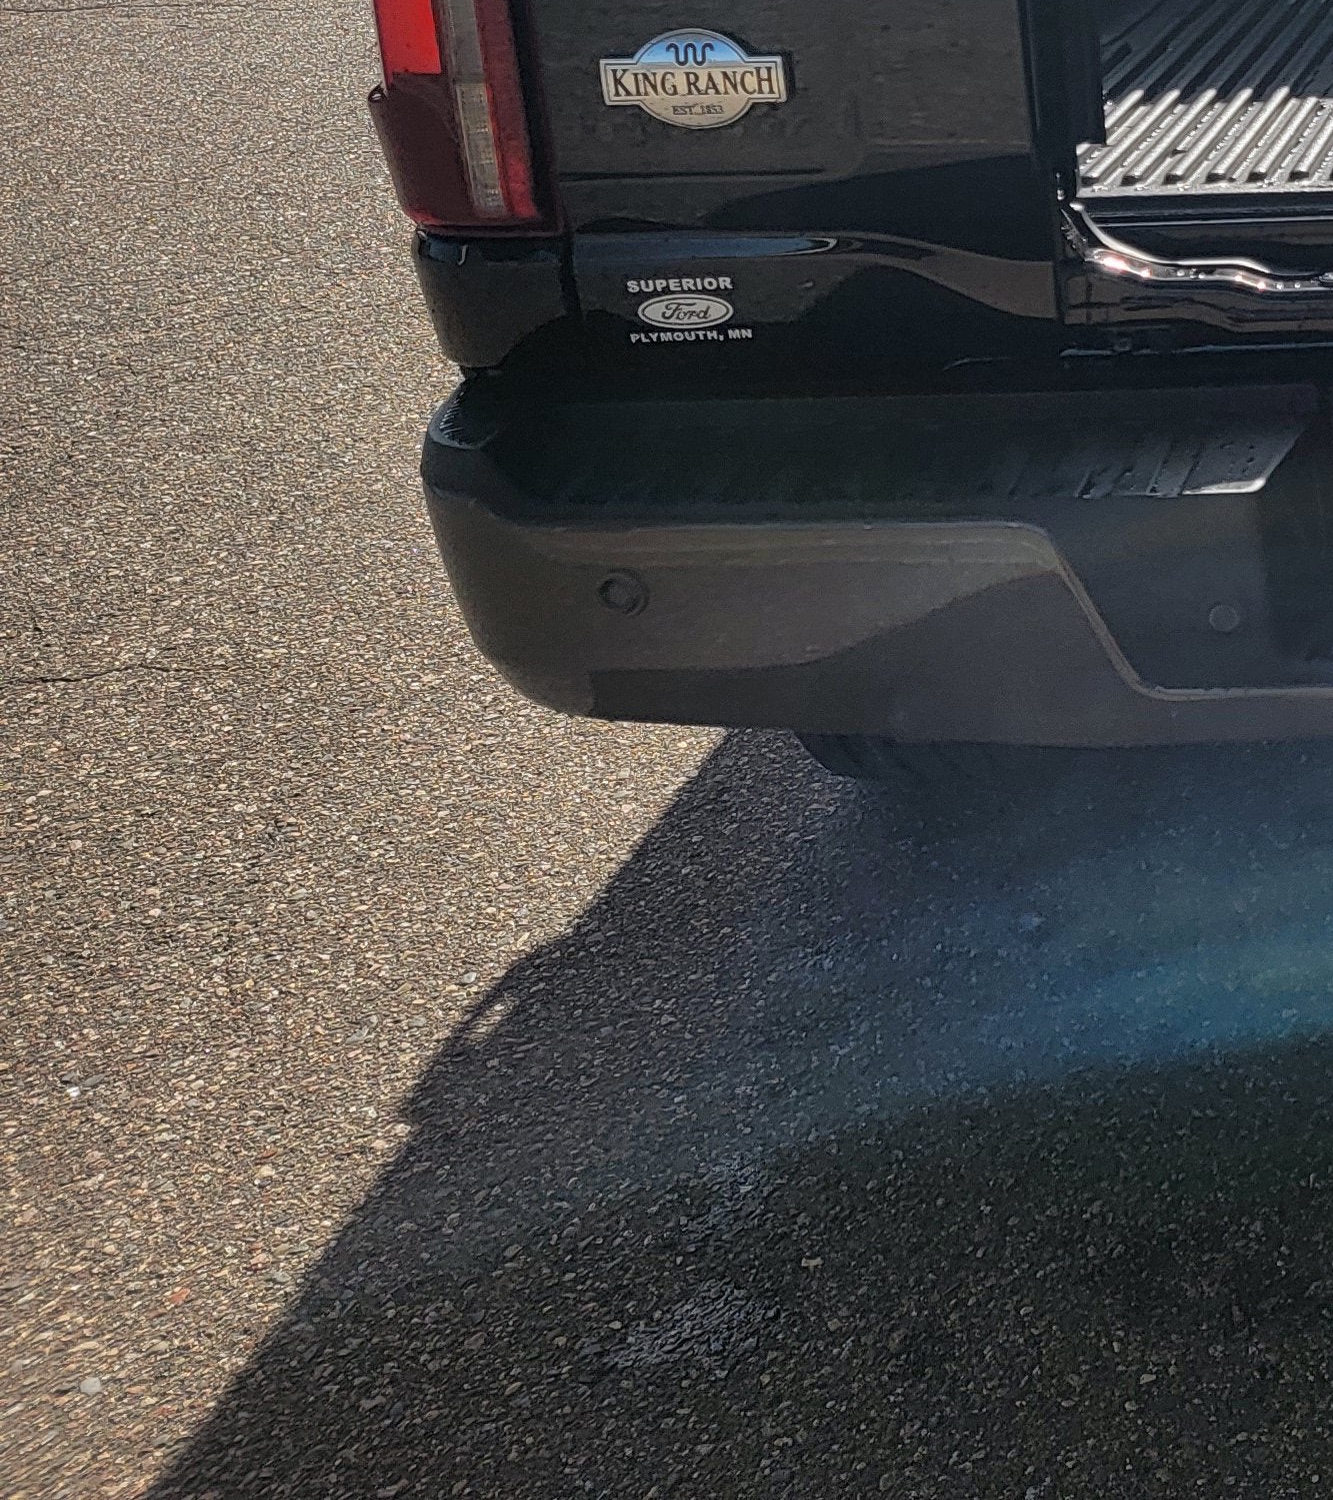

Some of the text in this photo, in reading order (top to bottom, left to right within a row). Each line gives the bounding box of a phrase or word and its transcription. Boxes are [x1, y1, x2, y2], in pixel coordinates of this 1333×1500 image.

[609, 66, 777, 98] KING RANCH
[626, 276, 734, 294] SUPERIOR
[661, 302, 711, 322] Ford
[629, 328, 752, 344] PLYMOUTH, MN
